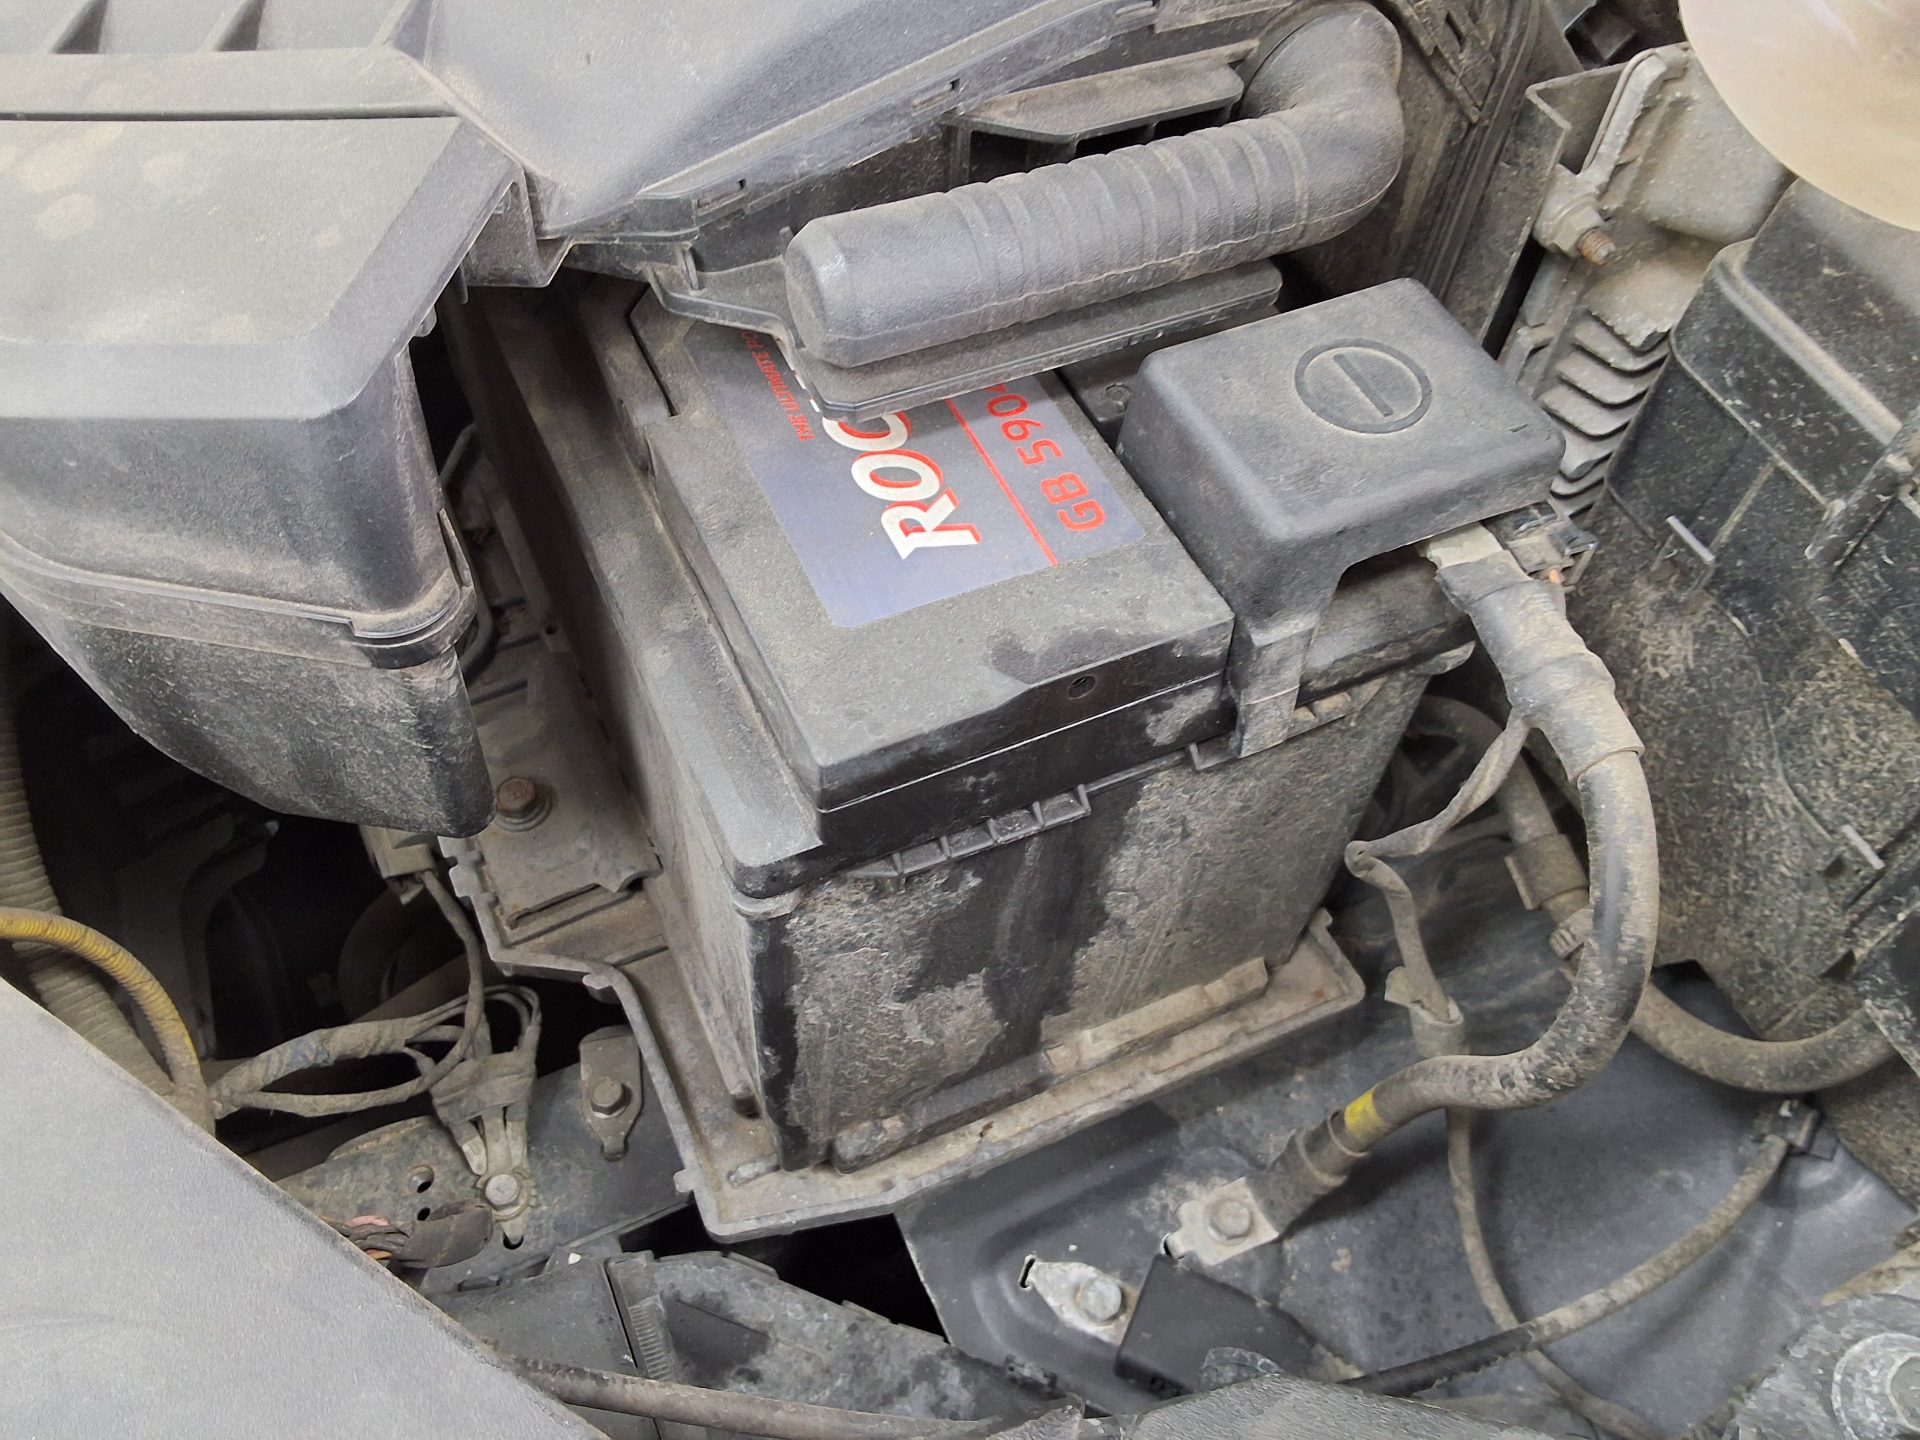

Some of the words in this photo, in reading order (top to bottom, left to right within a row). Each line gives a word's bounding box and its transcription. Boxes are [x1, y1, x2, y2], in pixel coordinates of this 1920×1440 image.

[739, 329, 765, 350] PO
[751, 351, 800, 412] ULTIMATE
[787, 413, 817, 441] THE
[984, 383, 1063, 466] 590
[797, 374, 982, 560] ROC
[1039, 471, 1105, 532] GB
